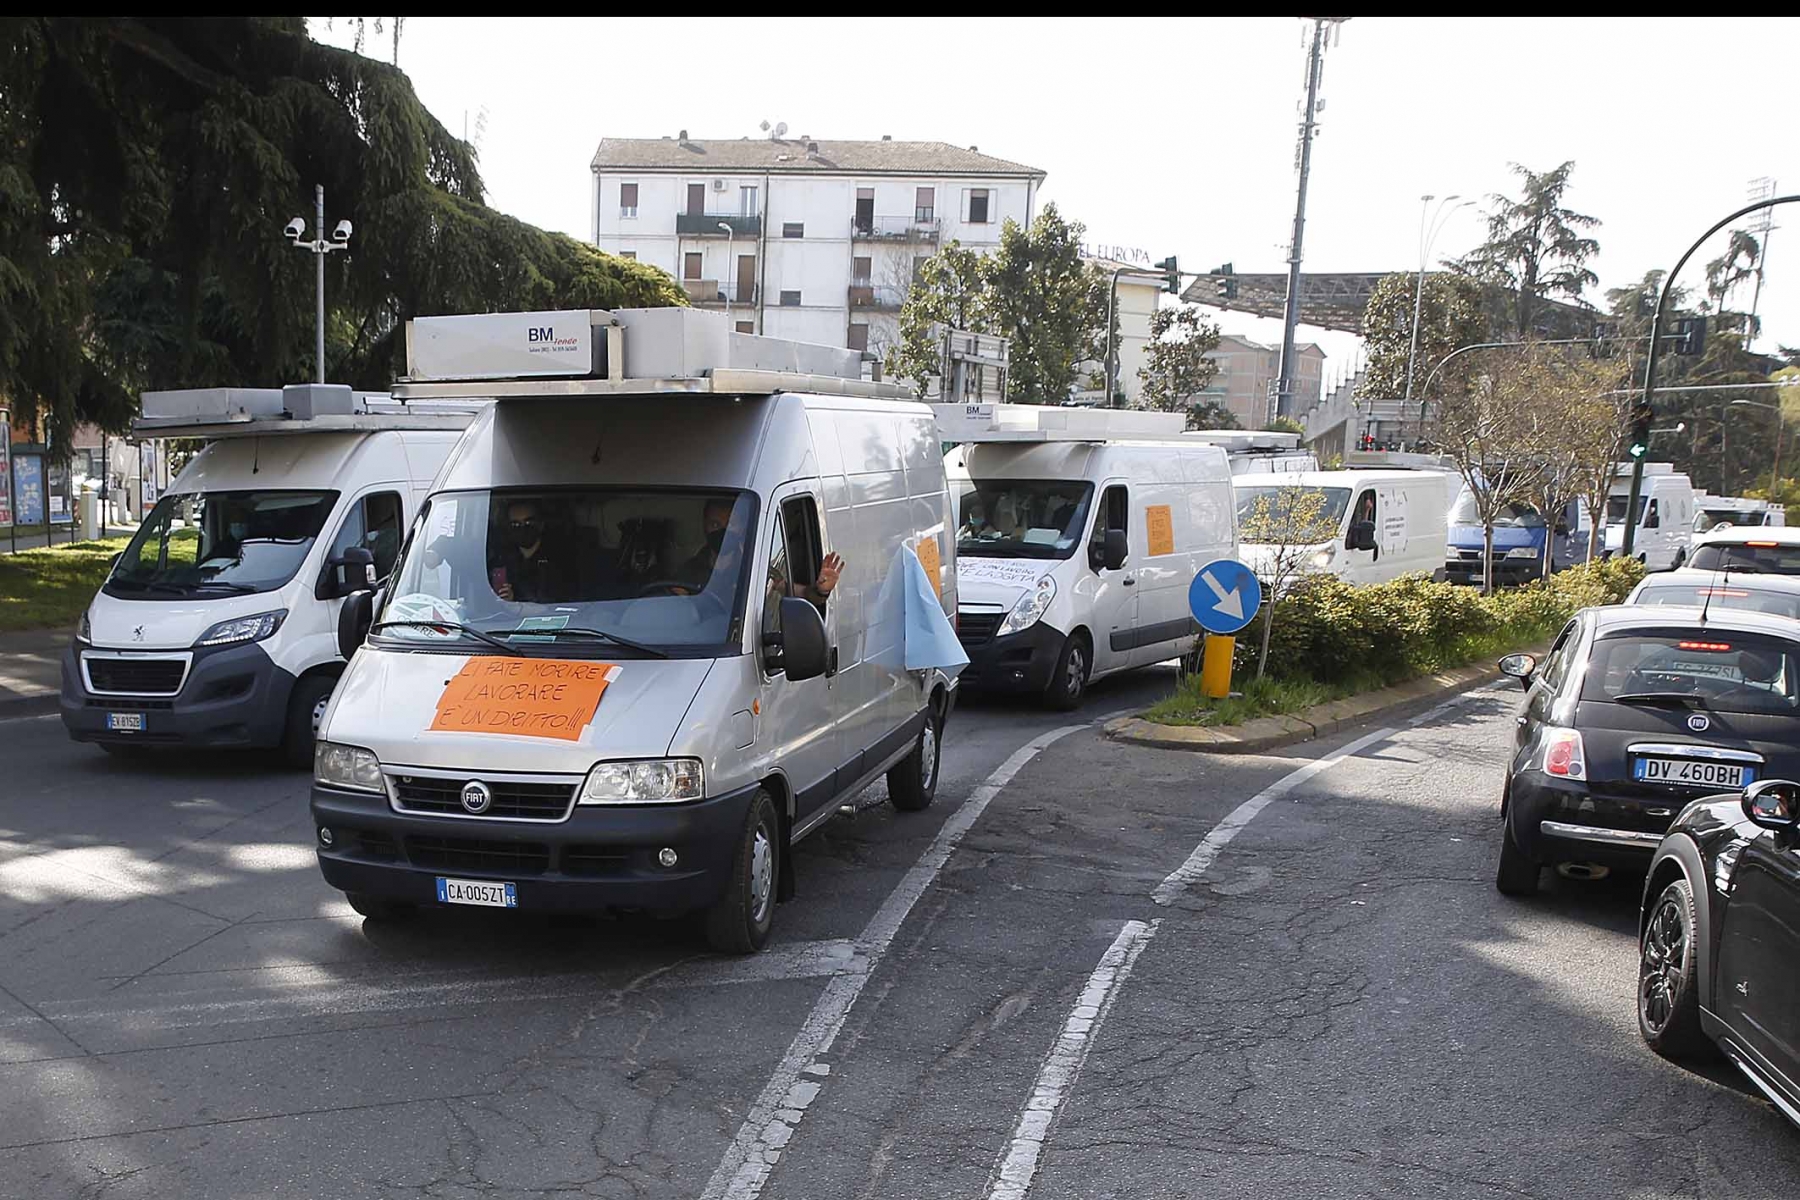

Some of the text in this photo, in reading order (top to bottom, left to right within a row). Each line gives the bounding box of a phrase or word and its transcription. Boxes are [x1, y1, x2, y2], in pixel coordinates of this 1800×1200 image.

[1098, 243, 1150, 264] EUROPA
[528, 327, 553, 341] BM
[966, 406, 980, 414] BM
[460, 661, 479, 677] CI
[482, 661, 524, 677] FATE
[464, 683, 568, 702] LAVORARE
[460, 708, 490, 726] UN
[465, 792, 484, 803] FIAT
